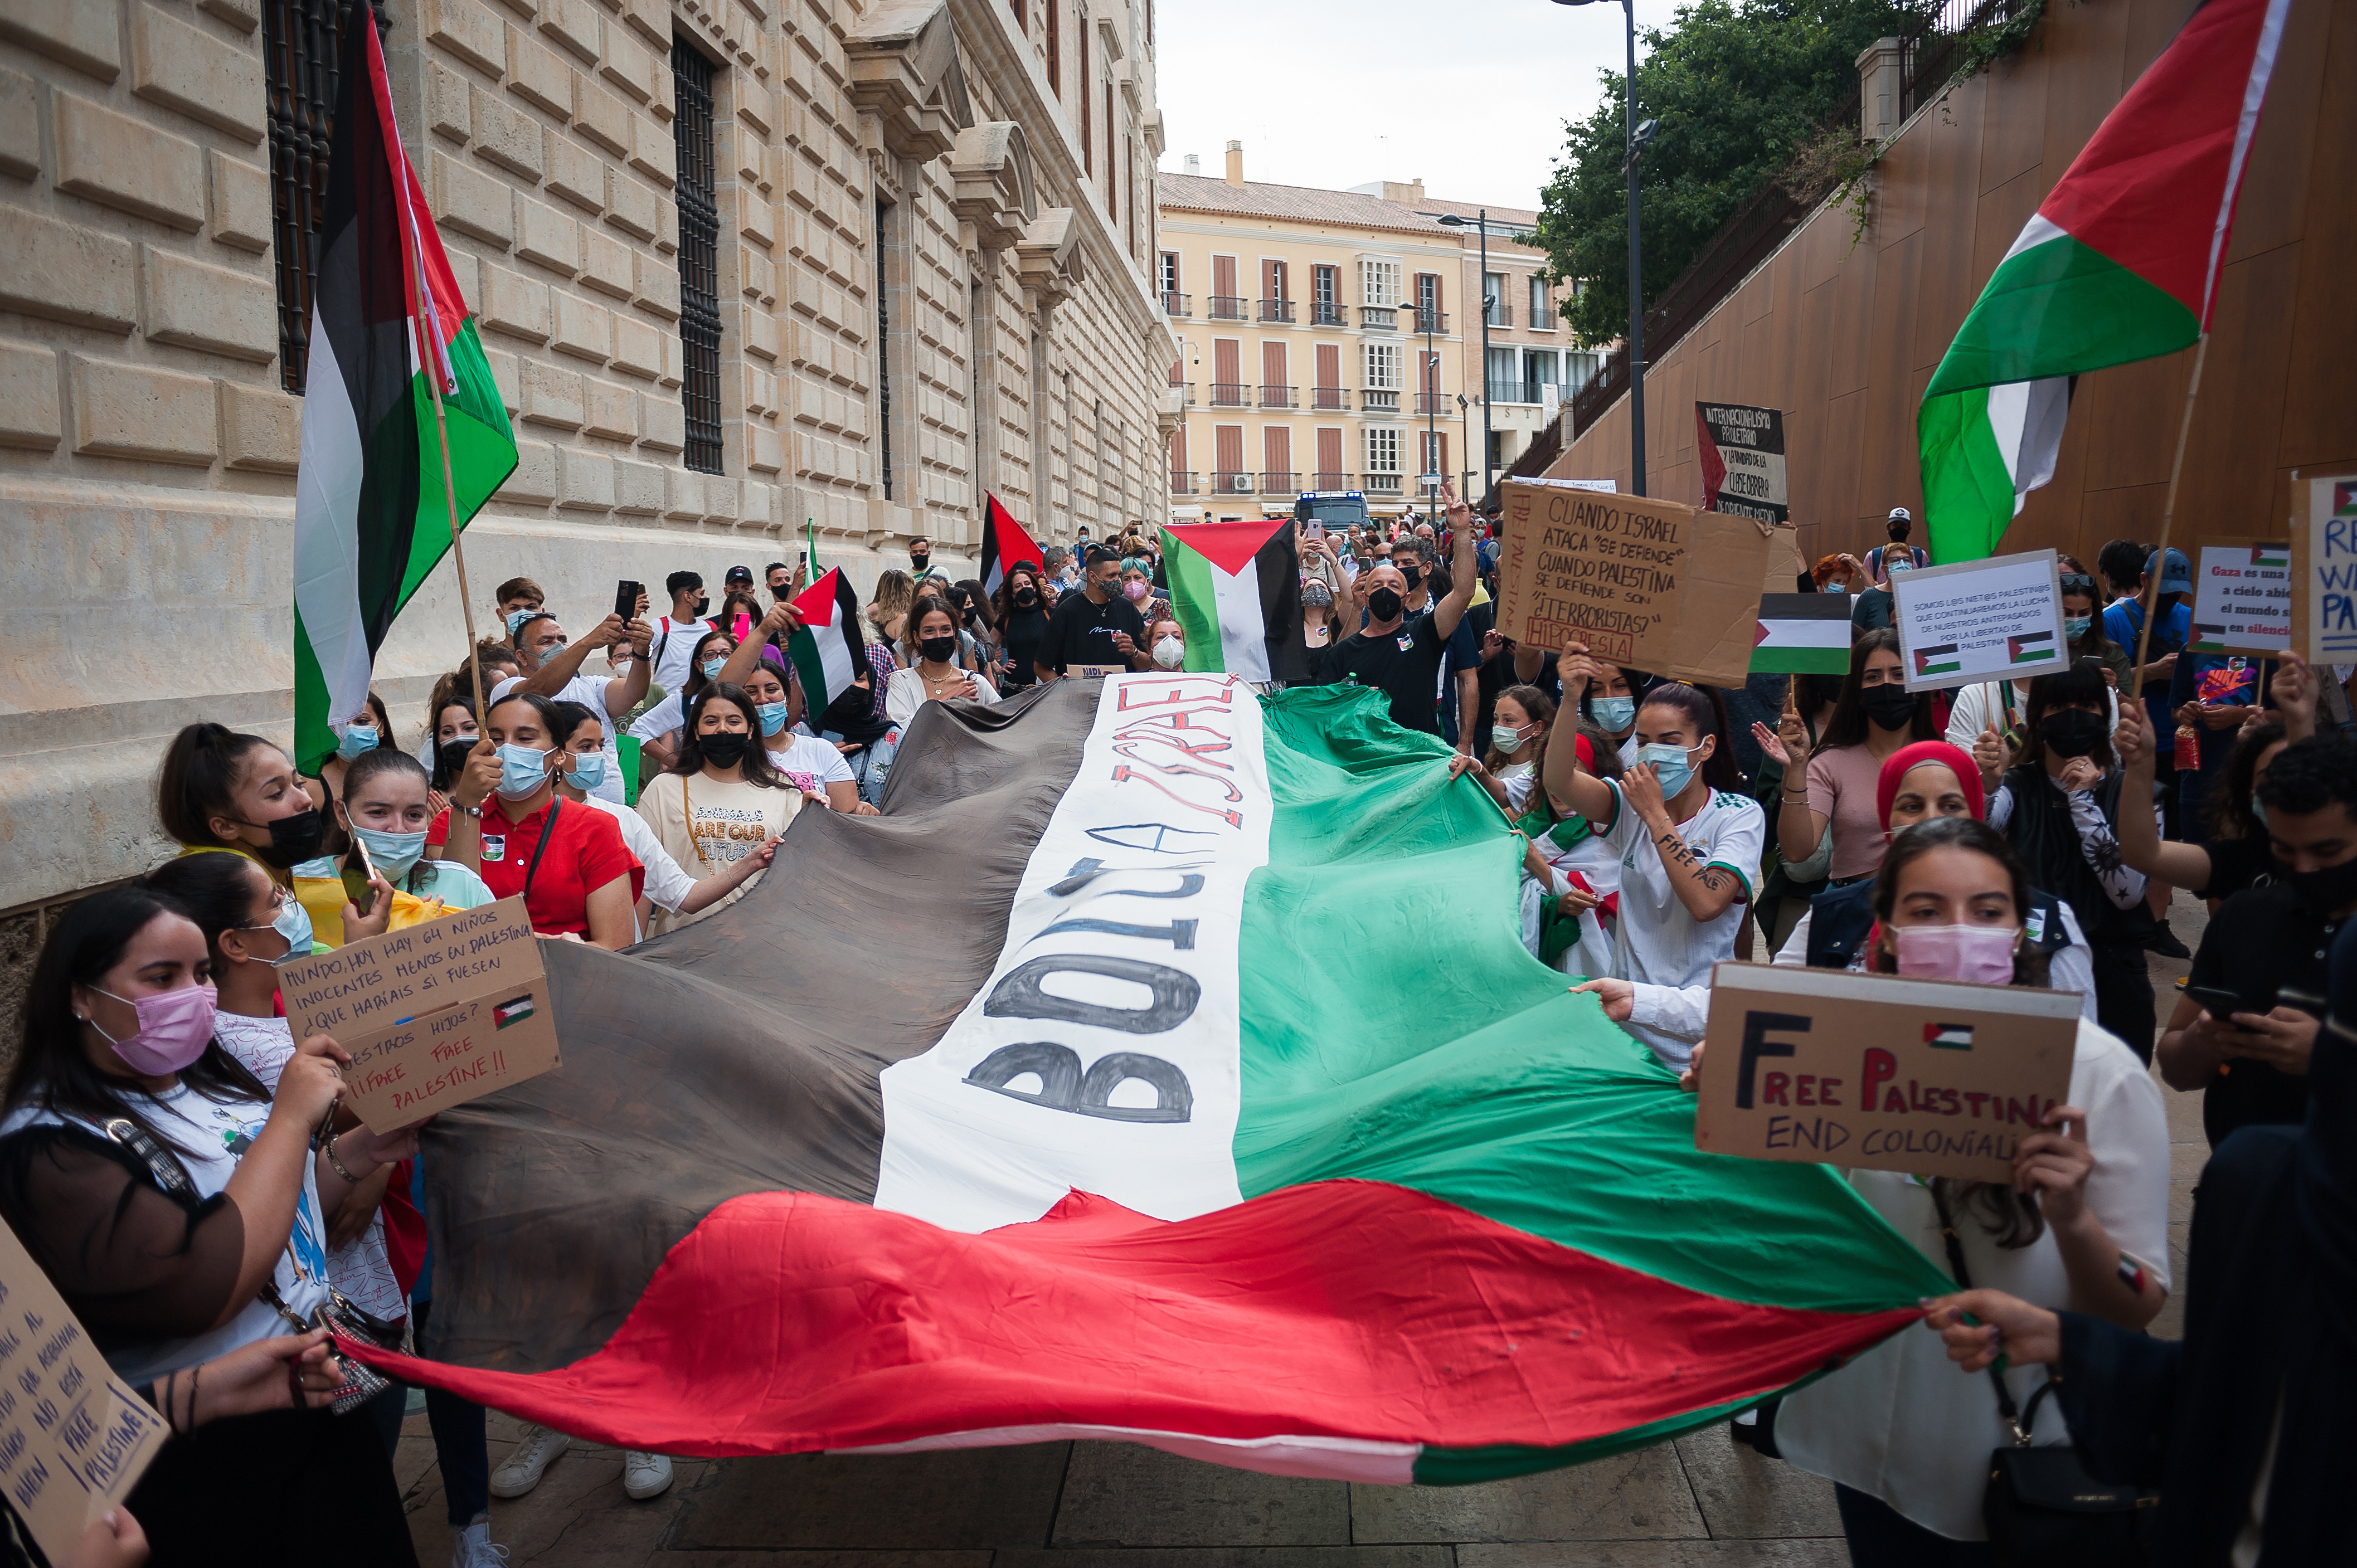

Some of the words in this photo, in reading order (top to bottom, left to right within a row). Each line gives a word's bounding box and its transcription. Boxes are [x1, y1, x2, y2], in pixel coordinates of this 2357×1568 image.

[1706, 407, 1771, 430] INTERNACIONALISMO
[1722, 426, 1757, 446] PROLETARIO
[1723, 450, 1727, 461] Y
[1753, 454, 1760, 466] DE
[1760, 455, 1766, 468] LA
[1729, 472, 1746, 495] CLASE
[1746, 475, 1770, 499] OBRERA
[1548, 496, 1619, 532] CUANDO
[1620, 512, 1679, 544] ISRAEL
[1543, 527, 1588, 552] ATACA
[1537, 551, 1596, 578] CUANDO
[1598, 561, 1675, 593] PALESTINA
[2211, 566, 2241, 577] Gaza
[2244, 569, 2257, 578] es
[2261, 570, 2284, 579] una
[1535, 572, 1551, 587] SE
[1557, 577, 1615, 599] DEFIENDE
[1624, 592, 1651, 605] SON
[1914, 600, 1944, 611] SOMOS
[1946, 597, 1964, 606] L@S
[1965, 593, 1997, 603] NIET@S
[1998, 584, 2050, 599] PALESTIN@S
[2233, 586, 2263, 597] cielo
[1916, 613, 1933, 622] QUE
[1935, 603, 2008, 620] CONTINUAREMOS
[2009, 601, 2019, 610] LA
[2021, 596, 2050, 607] LUCHA
[1934, 617, 1979, 631] NUESTROS
[1980, 609, 2041, 625] ANTEPASADOS
[2220, 603, 2232, 613] el
[2234, 605, 2279, 616] mundo
[1940, 633, 1957, 642] POR
[1959, 631, 1970, 640] LA
[1971, 625, 2010, 637] LIBERTAD
[2229, 624, 2244, 632] en
[1961, 638, 2006, 650] PALESTINA
[2205, 670, 2244, 687] NIKE
[1111, 676, 1243, 830] ISRAEL
[696, 807, 764, 821] ANIMALS
[694, 822, 726, 840] ARE
[728, 824, 766, 842] OUR
[698, 842, 757, 861] FUTUR
[349, 948, 375, 972] HOY
[383, 937, 414, 959] HAY
[422, 928, 442, 944] 64
[452, 911, 498, 935] NIÑOS
[295, 970, 383, 1011] INOCENTES
[396, 951, 444, 977] MENOS
[448, 944, 465, 961] EN
[470, 924, 531, 955] PALESTINA
[304, 1007, 347, 1038] ¿QUE
[422, 973, 438, 990] SI
[447, 957, 501, 982] FUESEN
[341, 1031, 415, 1070] UESTROS
[431, 1003, 479, 1036] HIJOS?
[431, 1036, 474, 1063] FREE
[1736, 1010, 1843, 1109] FREE
[1766, 1116, 1850, 1152] END
[24, 1311, 44, 1336] AL
[17, 1367, 41, 1397] QUE
[32, 1397, 59, 1433] NO
[59, 1356, 85, 1400] ESTÁ
[14, 1454, 50, 1507] BIEN
